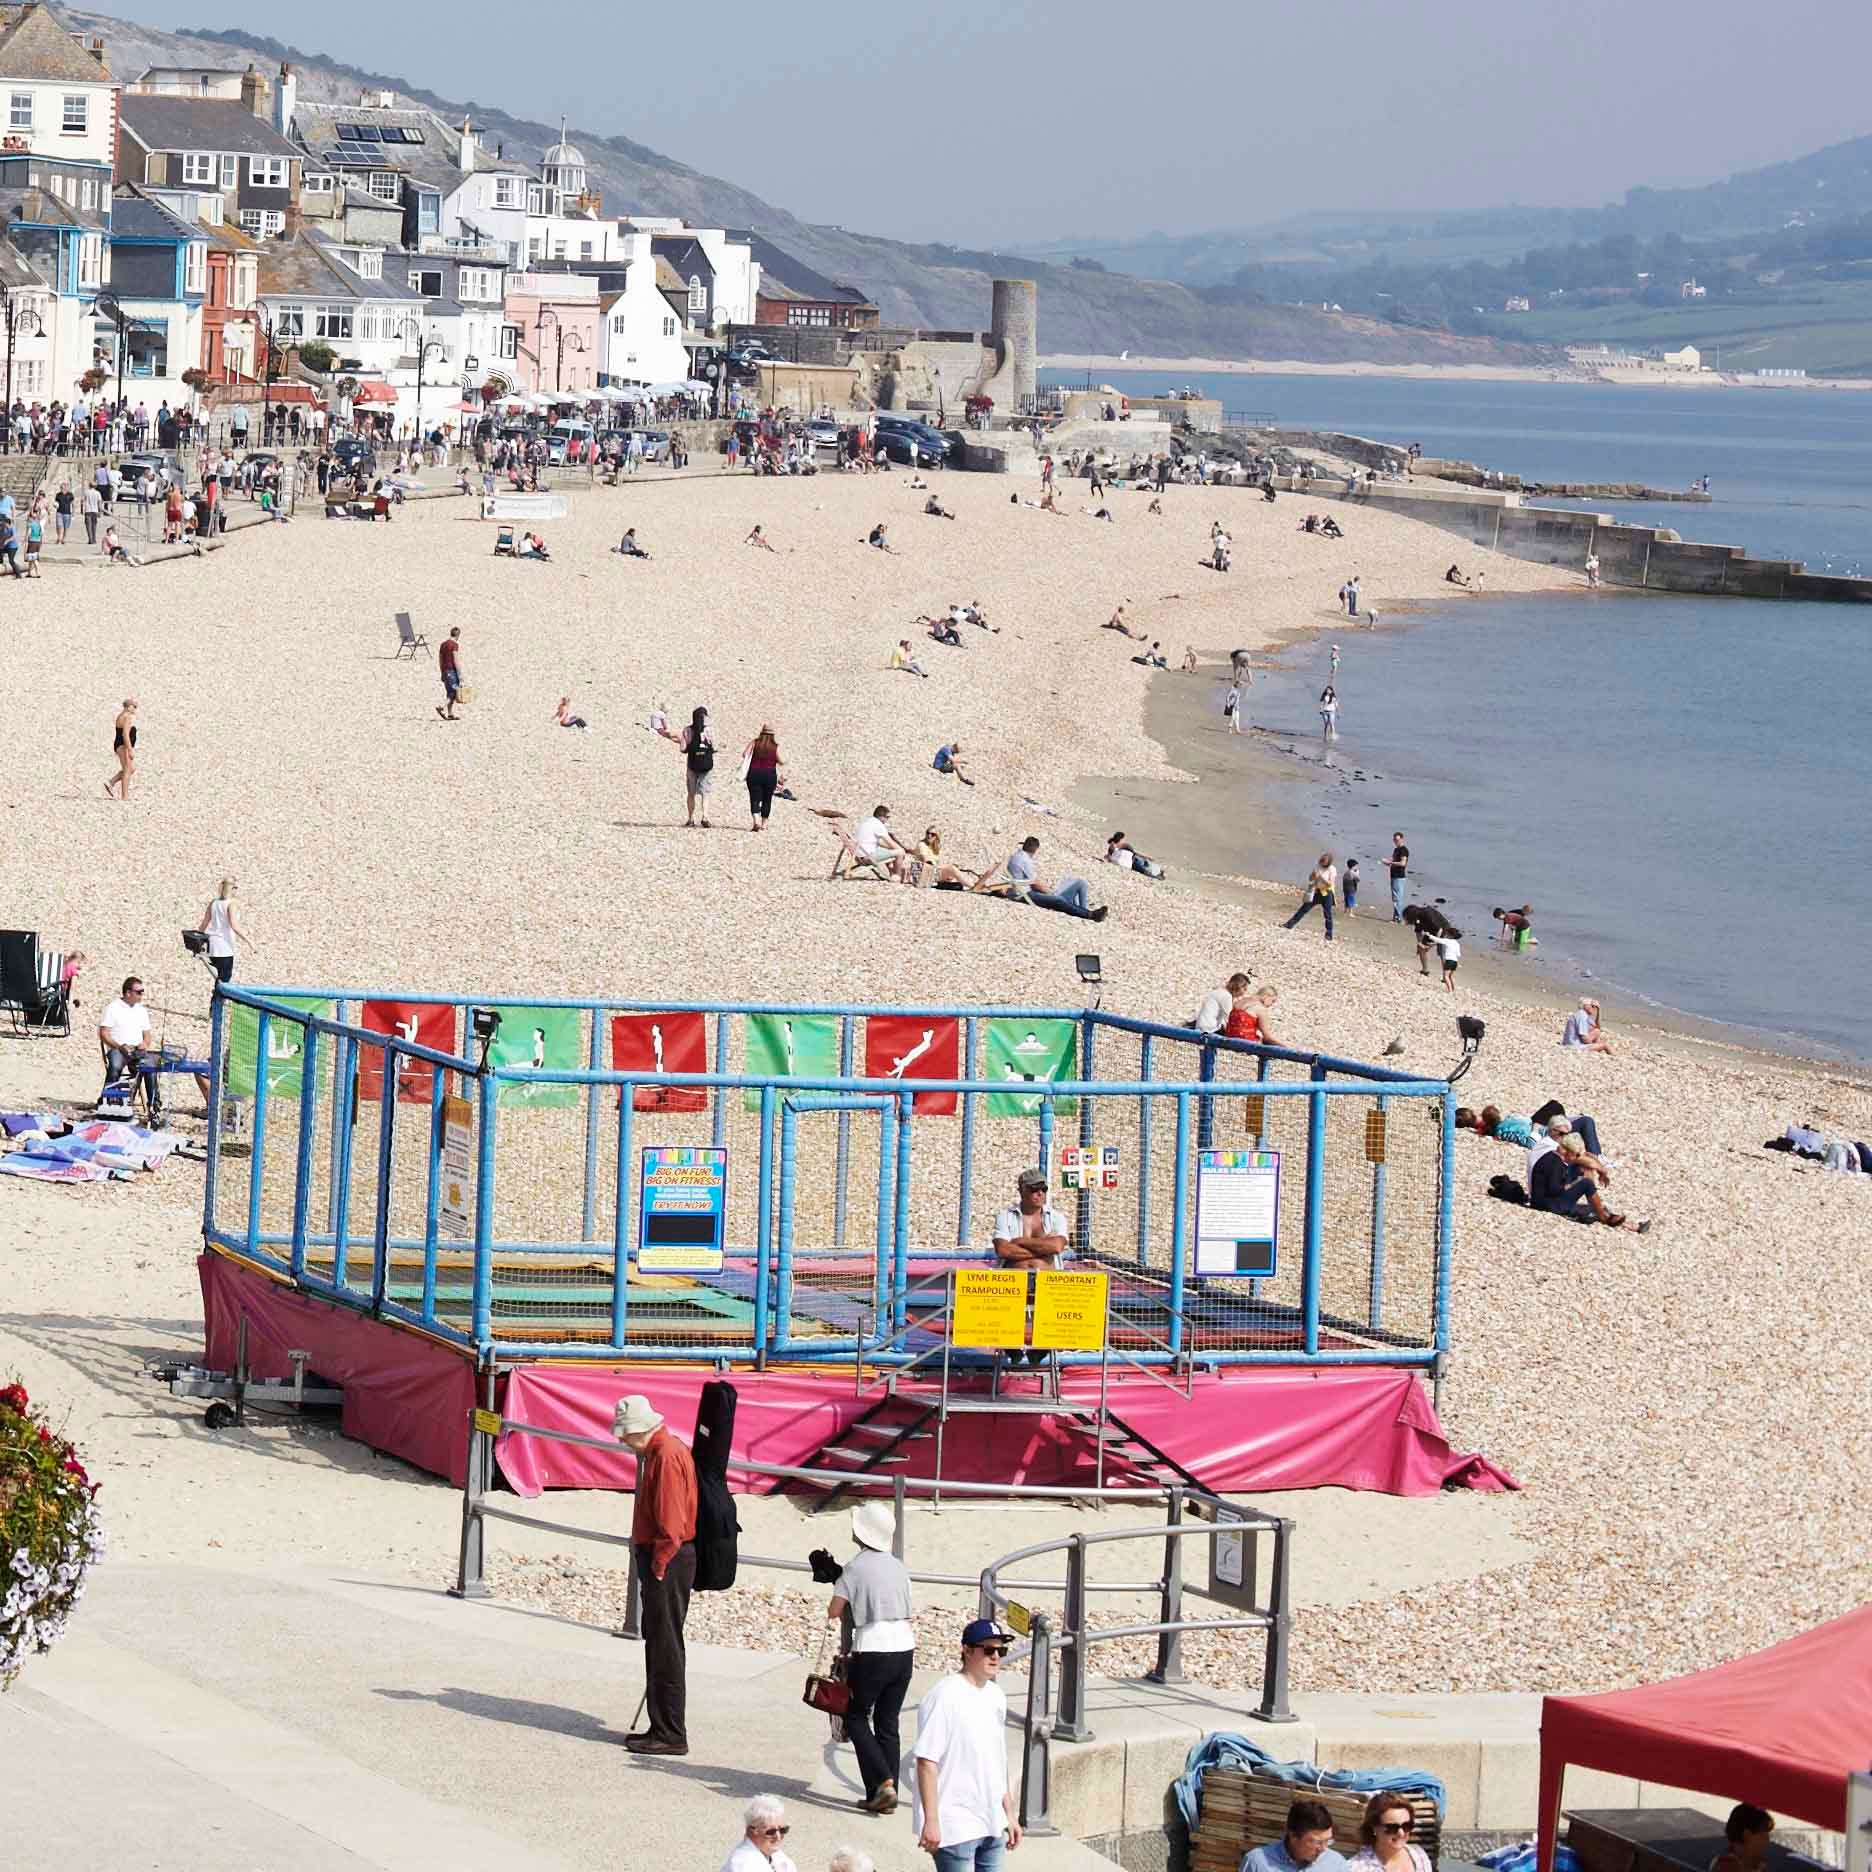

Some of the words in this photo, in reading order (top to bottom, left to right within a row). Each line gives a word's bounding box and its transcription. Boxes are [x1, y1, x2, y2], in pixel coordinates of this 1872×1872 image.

[967, 1273, 990, 1282] LYME
[992, 1274, 1016, 1283] REGIS
[1046, 1275, 1097, 1285] IMPORTANT
[961, 1286, 1021, 1296] TRAMPOLINES
[1056, 1312, 1083, 1320] USERS
